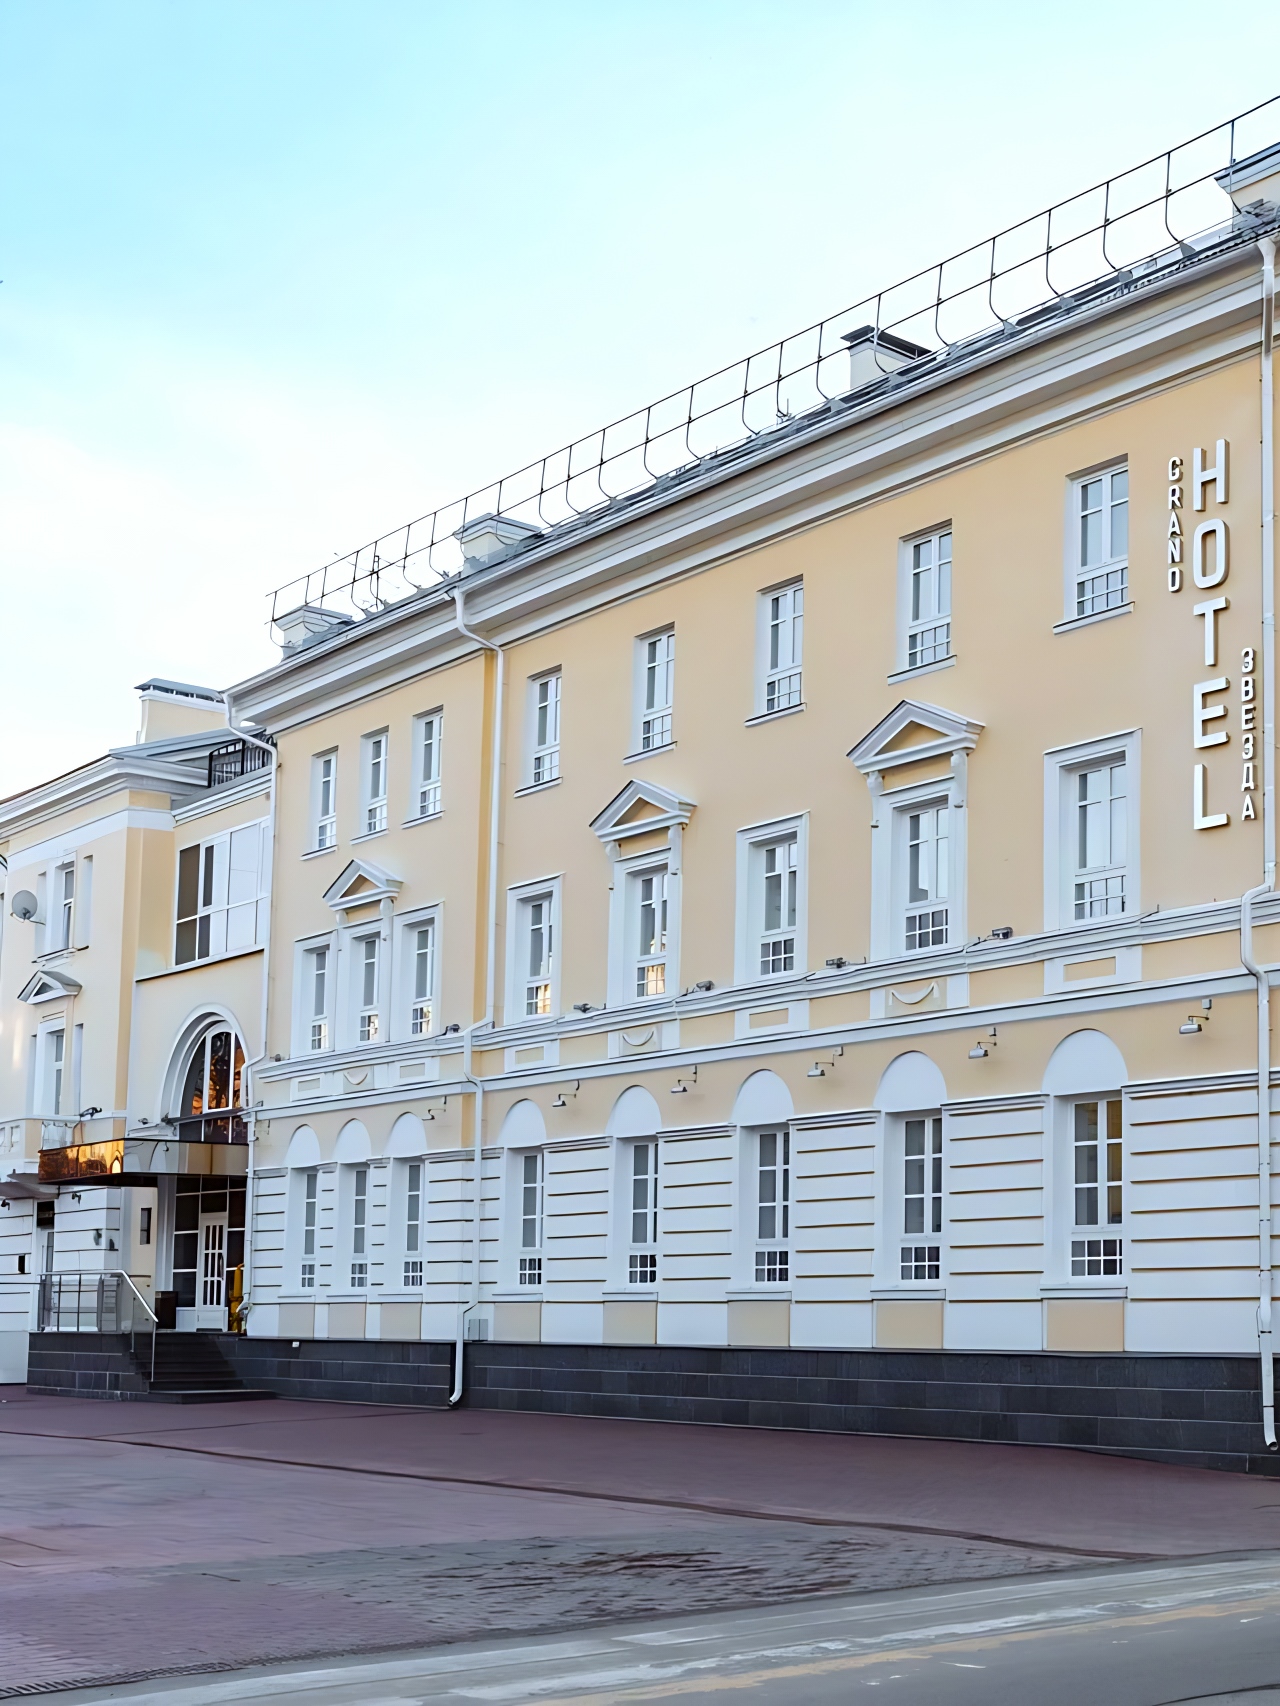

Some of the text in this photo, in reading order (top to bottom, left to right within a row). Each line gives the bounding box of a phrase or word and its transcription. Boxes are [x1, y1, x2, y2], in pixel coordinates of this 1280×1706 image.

[1168, 456, 1183, 593] GRAND
[1193, 438, 1230, 831] HOTEL
[1241, 647, 1257, 821] ЗВЕЗДА
